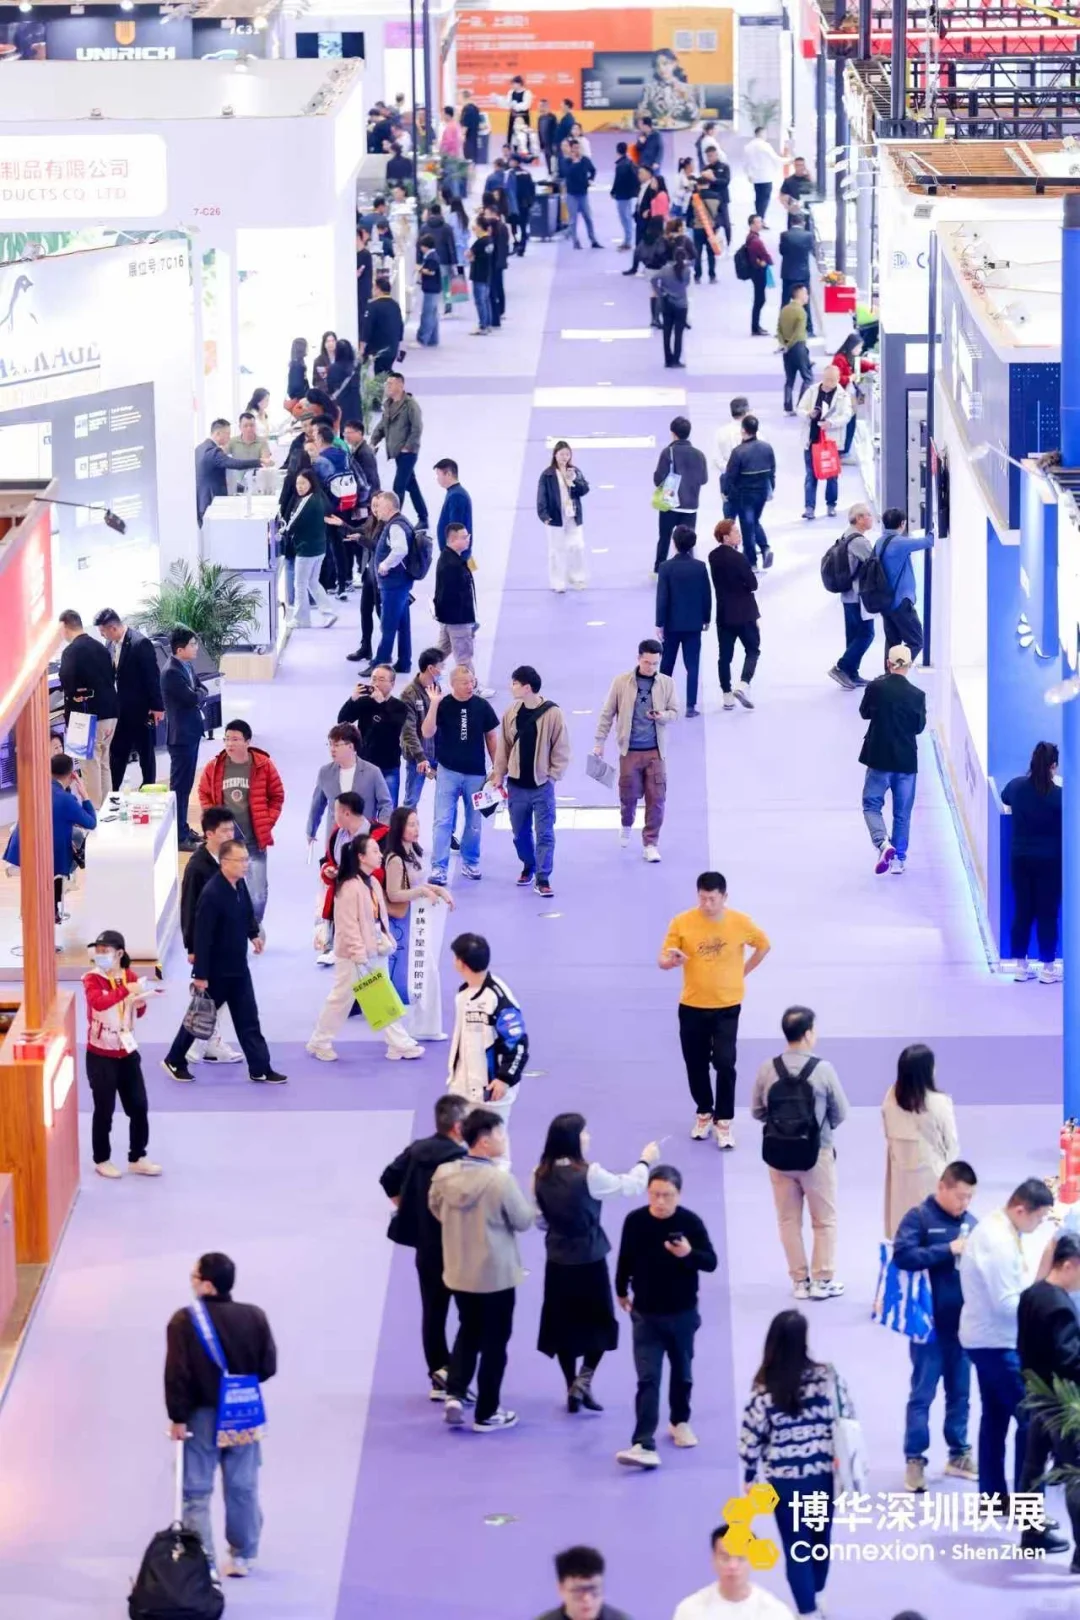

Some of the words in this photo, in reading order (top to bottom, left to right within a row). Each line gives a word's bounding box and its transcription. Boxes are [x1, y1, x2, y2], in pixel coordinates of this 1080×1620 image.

[76, 47, 176, 60] UNIRICH
[0, 159, 129, 180] 制品有限公司
[193, 207, 221, 216] 7-C26
